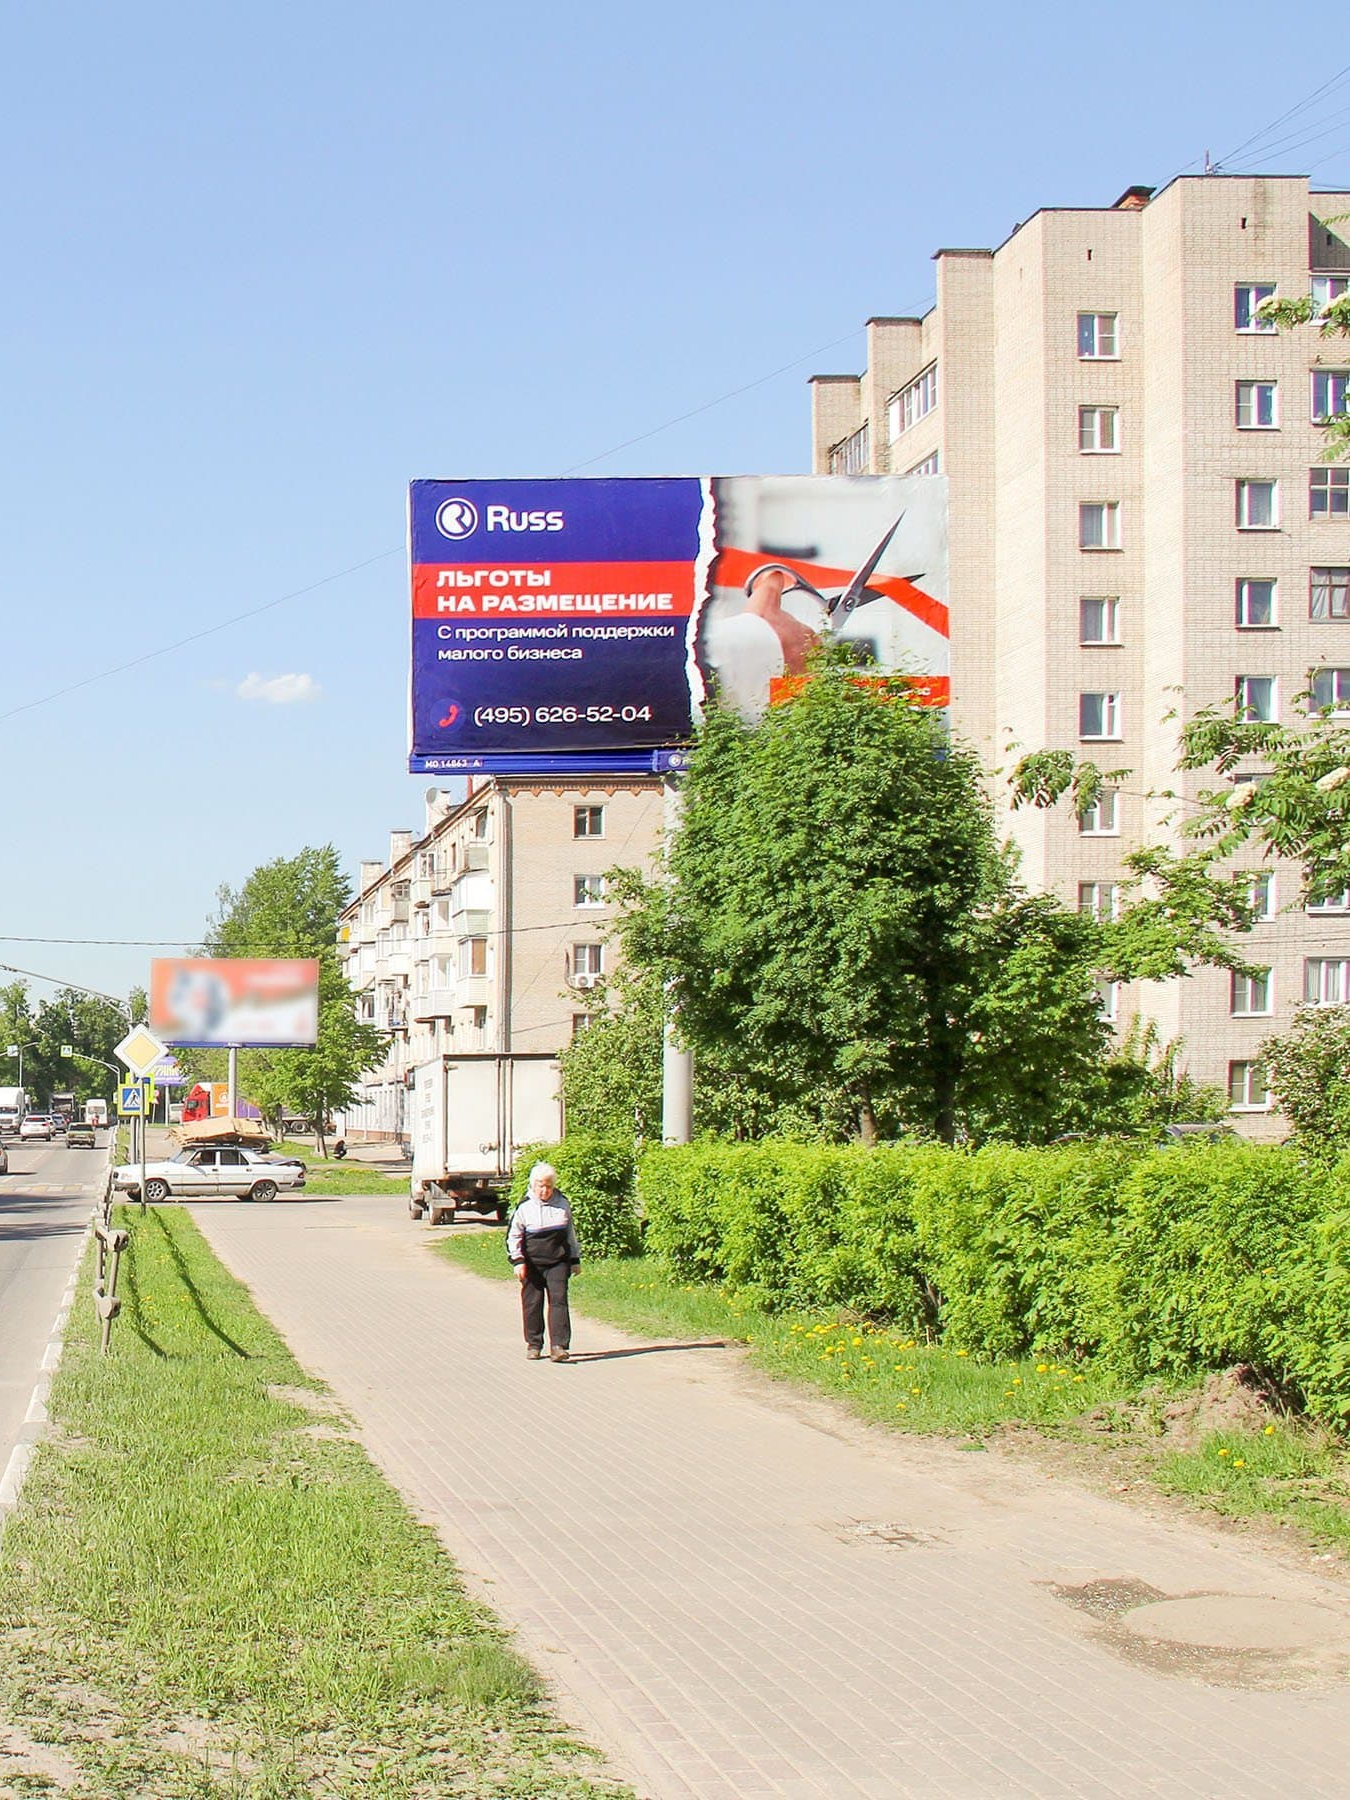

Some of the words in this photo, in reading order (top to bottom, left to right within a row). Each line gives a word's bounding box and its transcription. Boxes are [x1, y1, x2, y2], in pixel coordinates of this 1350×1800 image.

[486, 505, 564, 532] Russ
[436, 570, 551, 588] ЛЬГОТЫ
[437, 595, 476, 613] НА
[482, 593, 674, 614] РАЗМЕЩЕНИЕ
[437, 626, 452, 640] С
[455, 623, 568, 642] программой
[572, 626, 675, 642] поддержки
[437, 648, 504, 661] малого
[507, 646, 583, 660] бизнеса
[474, 706, 530, 727] (495)
[535, 705, 652, 723] 626-52-04
